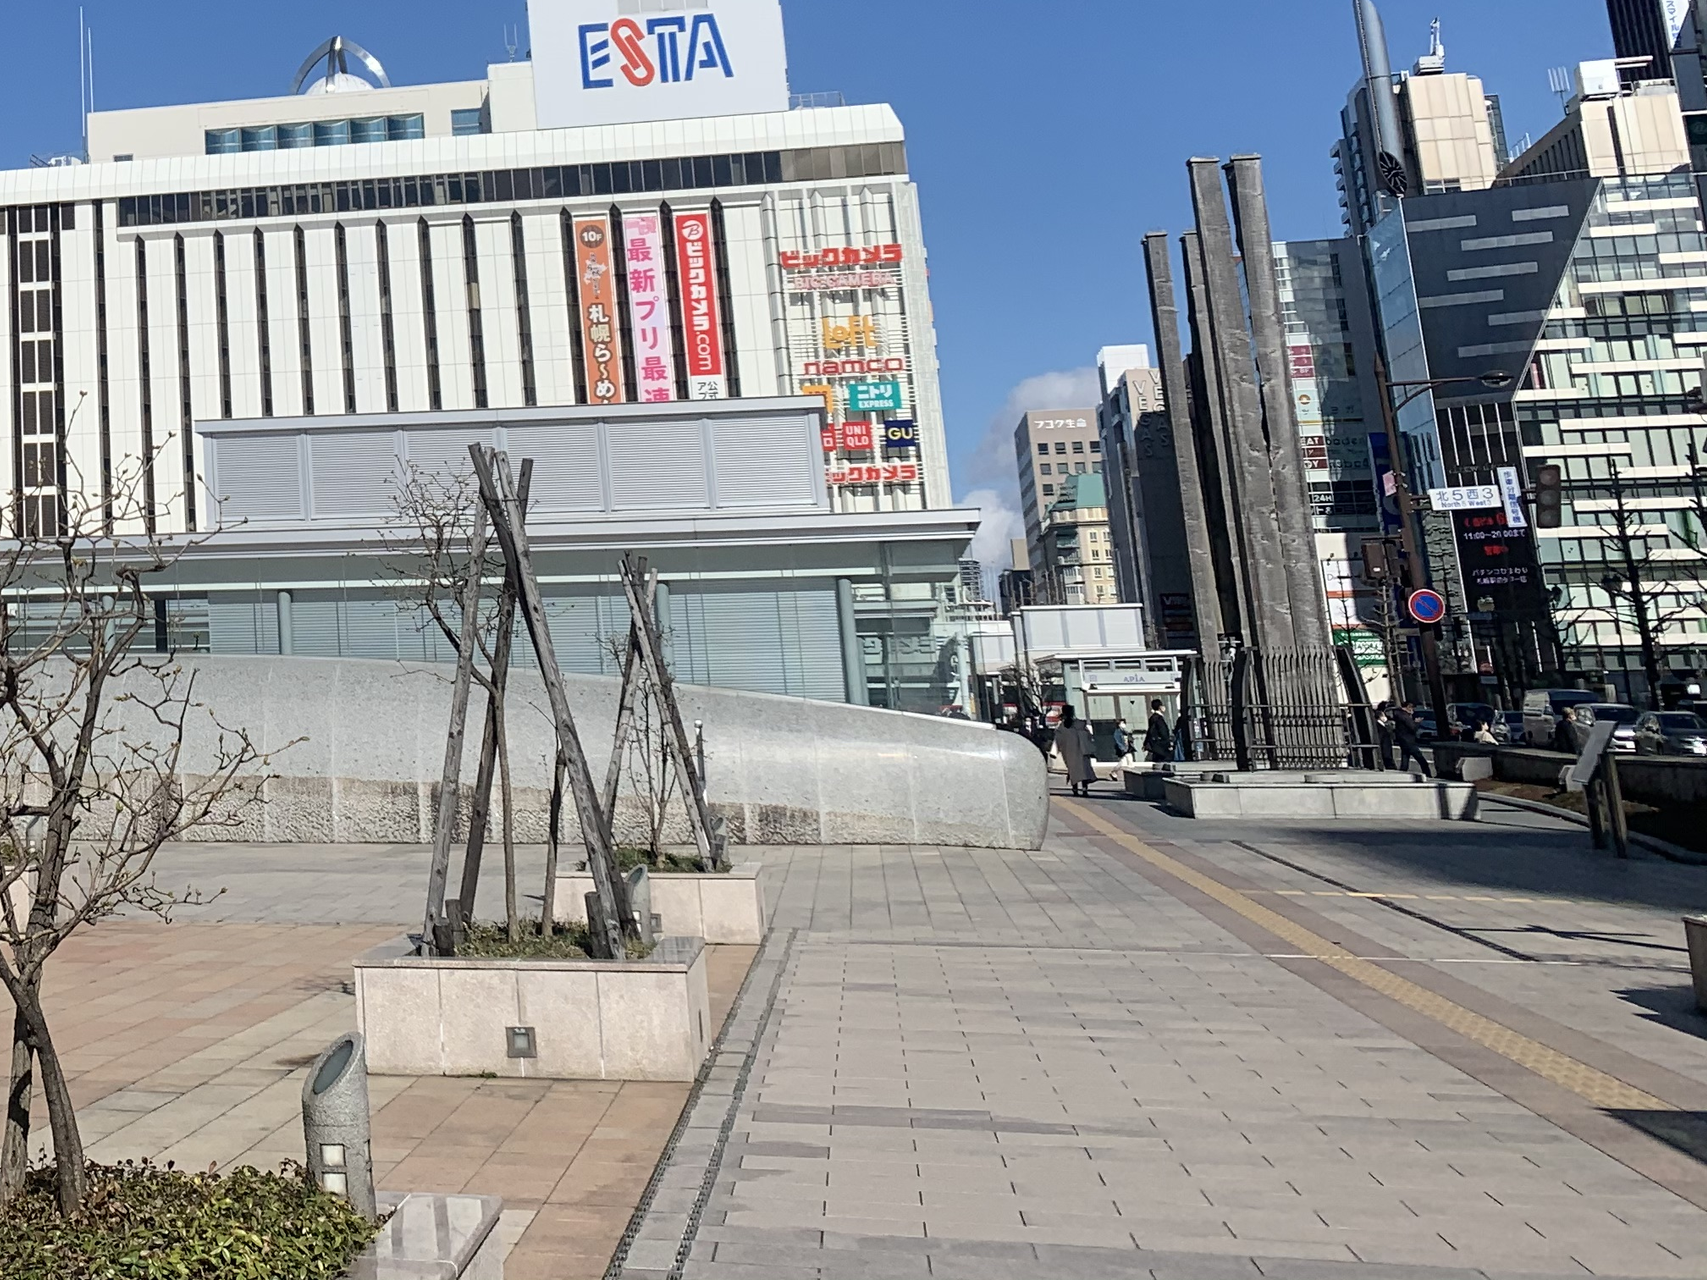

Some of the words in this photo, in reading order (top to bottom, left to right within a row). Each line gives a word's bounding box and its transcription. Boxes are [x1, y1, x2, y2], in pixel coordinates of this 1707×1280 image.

[578, 13, 734, 89] ESTA
[582, 231, 602, 242] 10F
[781, 243, 904, 271] ビックカメラ
[794, 275, 823, 291] BIC
[826, 271, 895, 289] CAMERA
[686, 241, 712, 371] ビックカメラ.com
[822, 315, 878, 349] Loft
[803, 357, 904, 376] namco
[857, 384, 893, 399] ニトリ
[858, 399, 894, 409] EXPRESS
[1133, 380, 1154, 458] VEGAS
[845, 425, 867, 435] UNI
[887, 427, 913, 440] GU
[846, 436, 869, 448] QLO
[826, 464, 917, 484] ックカメラ
[1441, 501, 1461, 509] North
[1123, 673, 1146, 683] APIA
